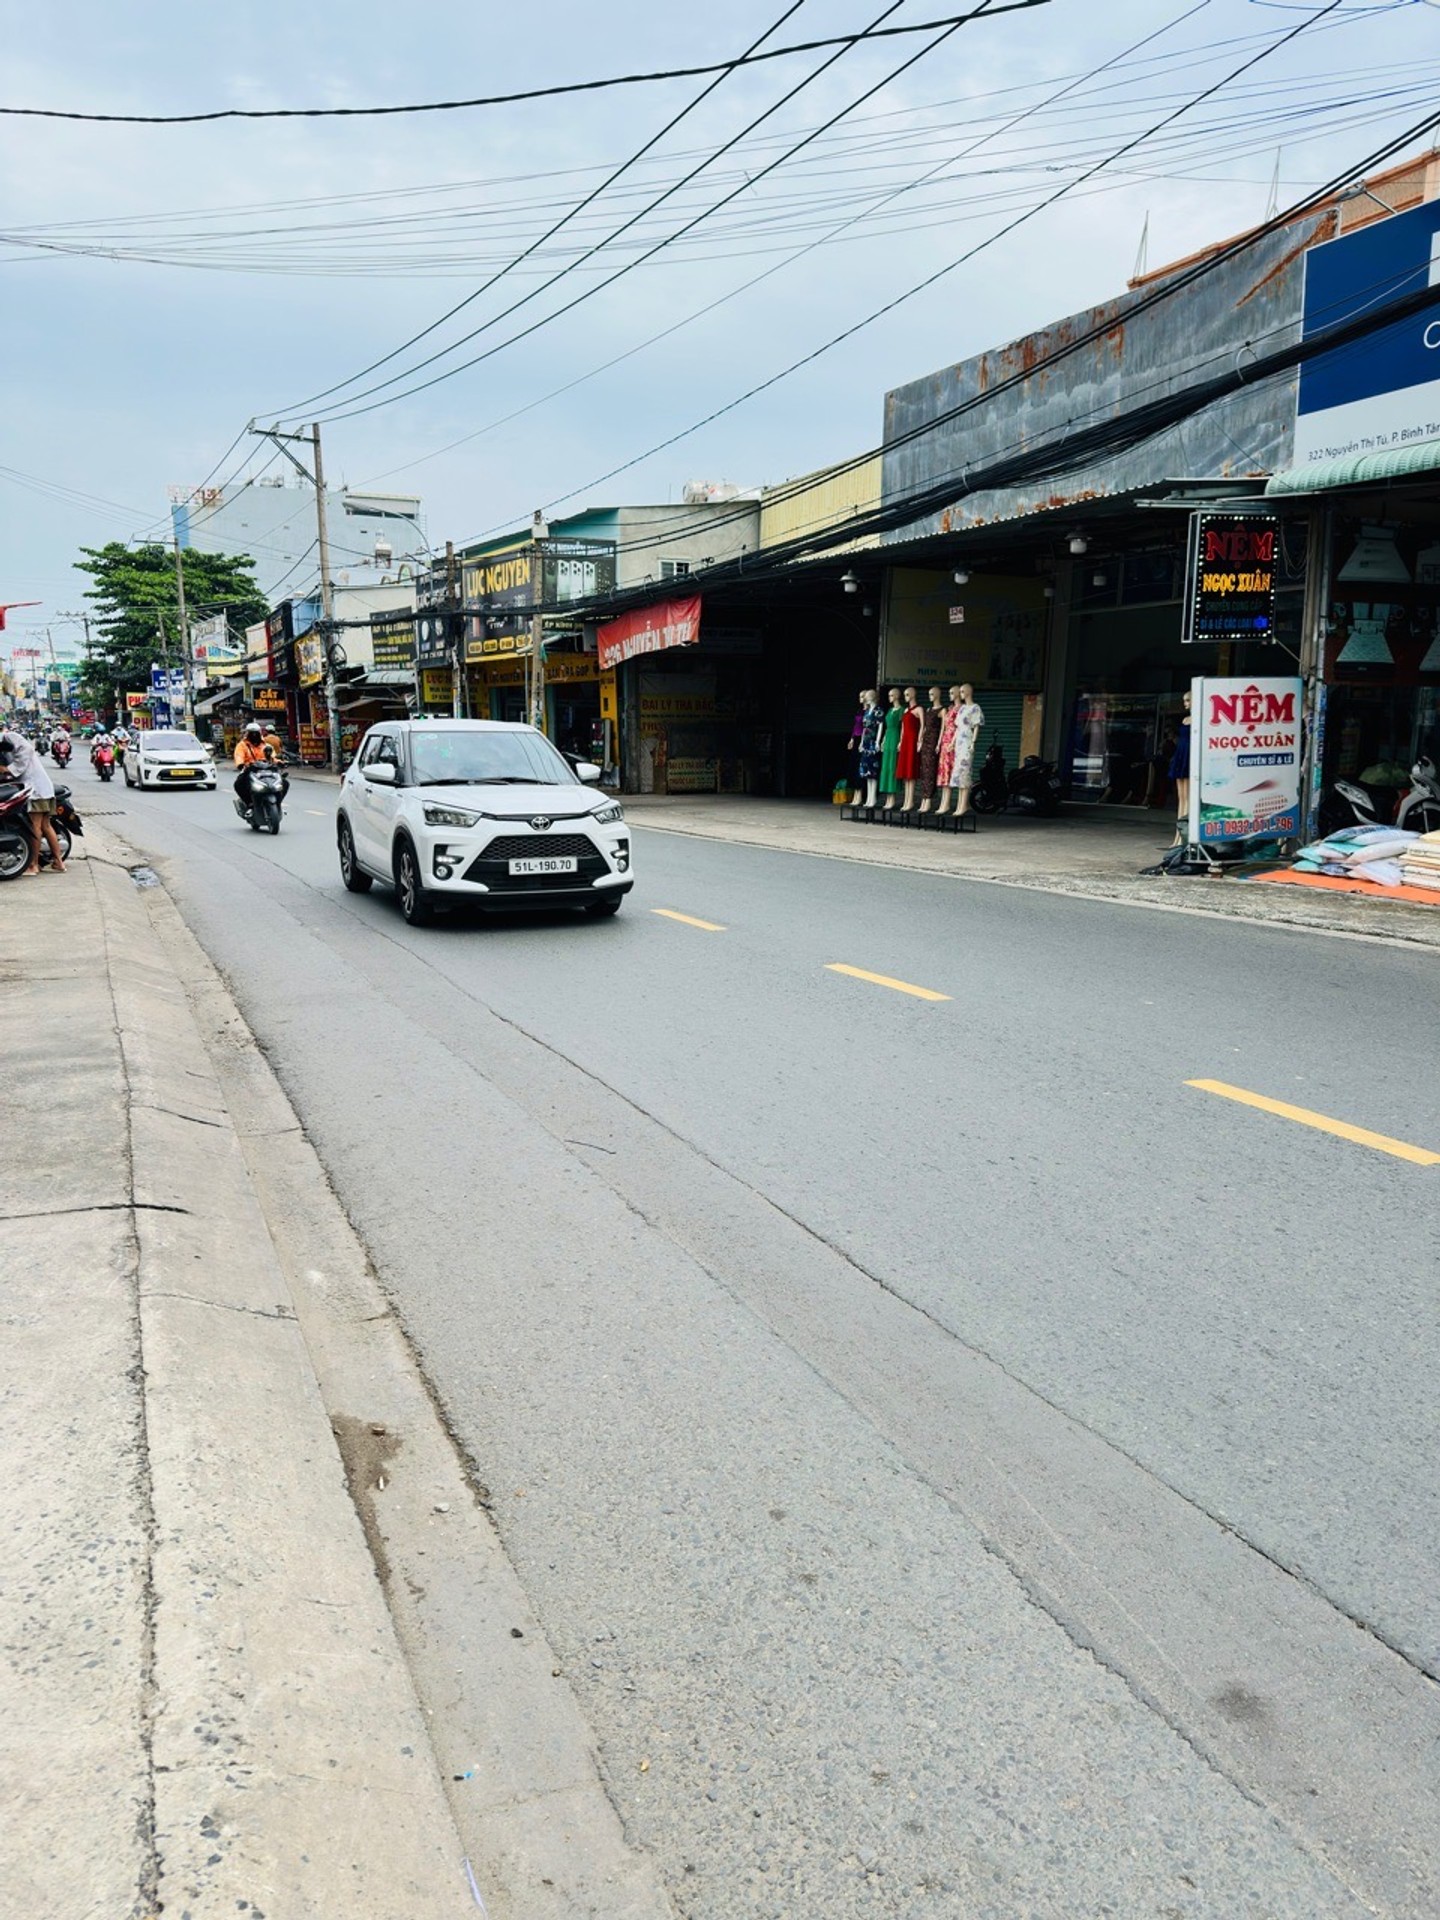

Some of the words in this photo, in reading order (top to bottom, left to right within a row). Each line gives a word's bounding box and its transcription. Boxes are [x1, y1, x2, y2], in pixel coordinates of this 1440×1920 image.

[1308, 449, 1323, 461] 322
[1206, 523, 1274, 569] NỆM
[1202, 572, 1236, 597] NGỌC
[1237, 568, 1271, 592] XUÂN
[1210, 685, 1295, 734] NỆM
[1209, 736, 1249, 751] NGỌC
[1253, 732, 1295, 749] XUÂN
[515, 859, 571, 872] 51L-190.70
